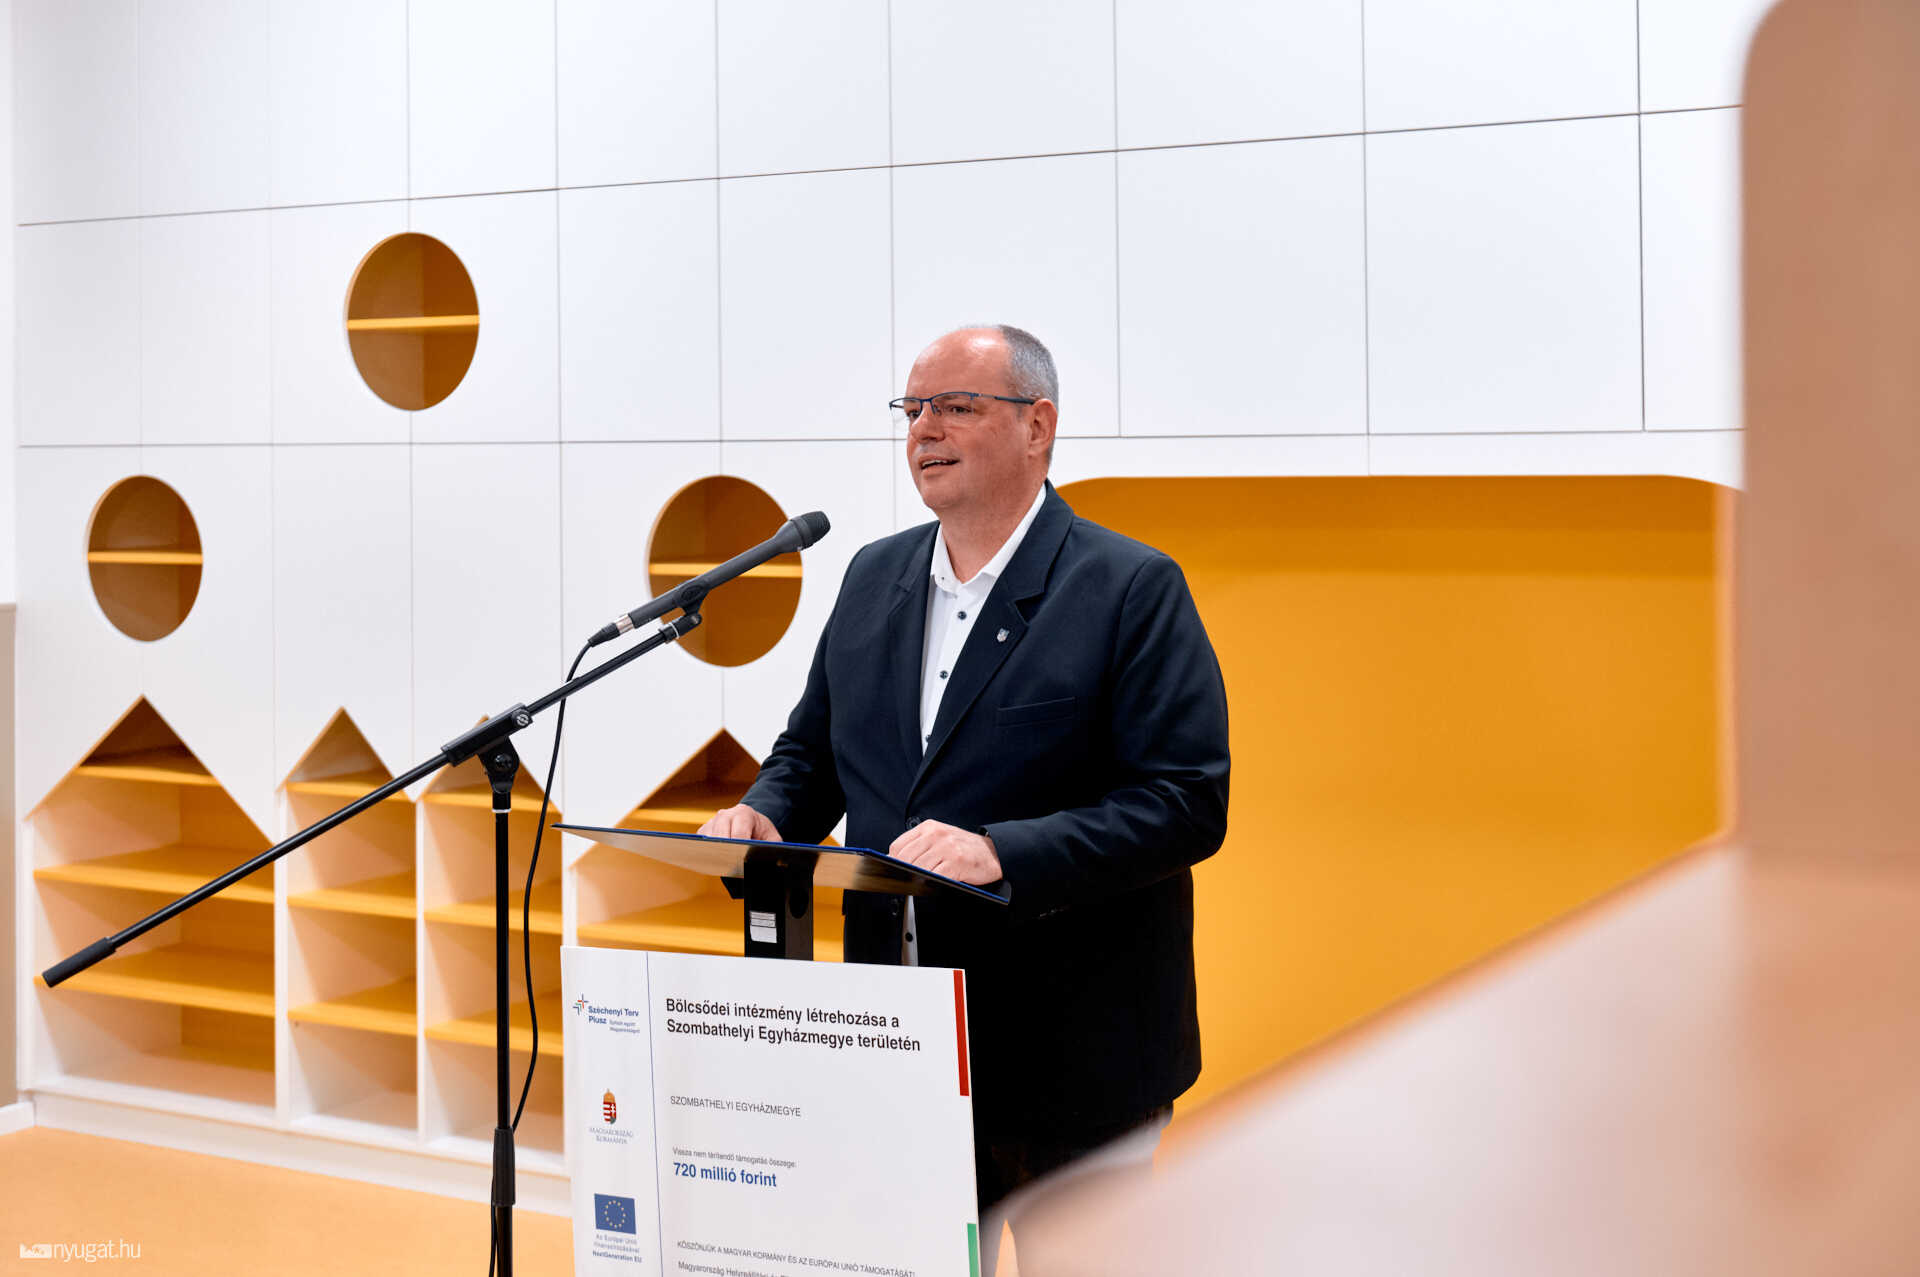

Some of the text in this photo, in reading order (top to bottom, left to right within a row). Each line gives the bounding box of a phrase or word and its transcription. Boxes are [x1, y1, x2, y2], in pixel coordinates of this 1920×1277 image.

[588, 1015, 607, 1025] Plusz
[624, 1008, 639, 1017] Terv
[666, 998, 899, 1028] Bölcsődei intézmény létrehozása a
[667, 1019, 921, 1051] Szombathelyi Egyházmegye területén
[670, 1095, 801, 1117] SZOMBATHELYI EGYHÁZMEGYE
[693, 1150, 707, 1158] nem
[673, 1162, 776, 1187] 720 millió forint
[723, 1247, 751, 1257] MAGYAR
[798, 1256, 808, 1265] AZ
[841, 1261, 859, 1272] UNIÓ
